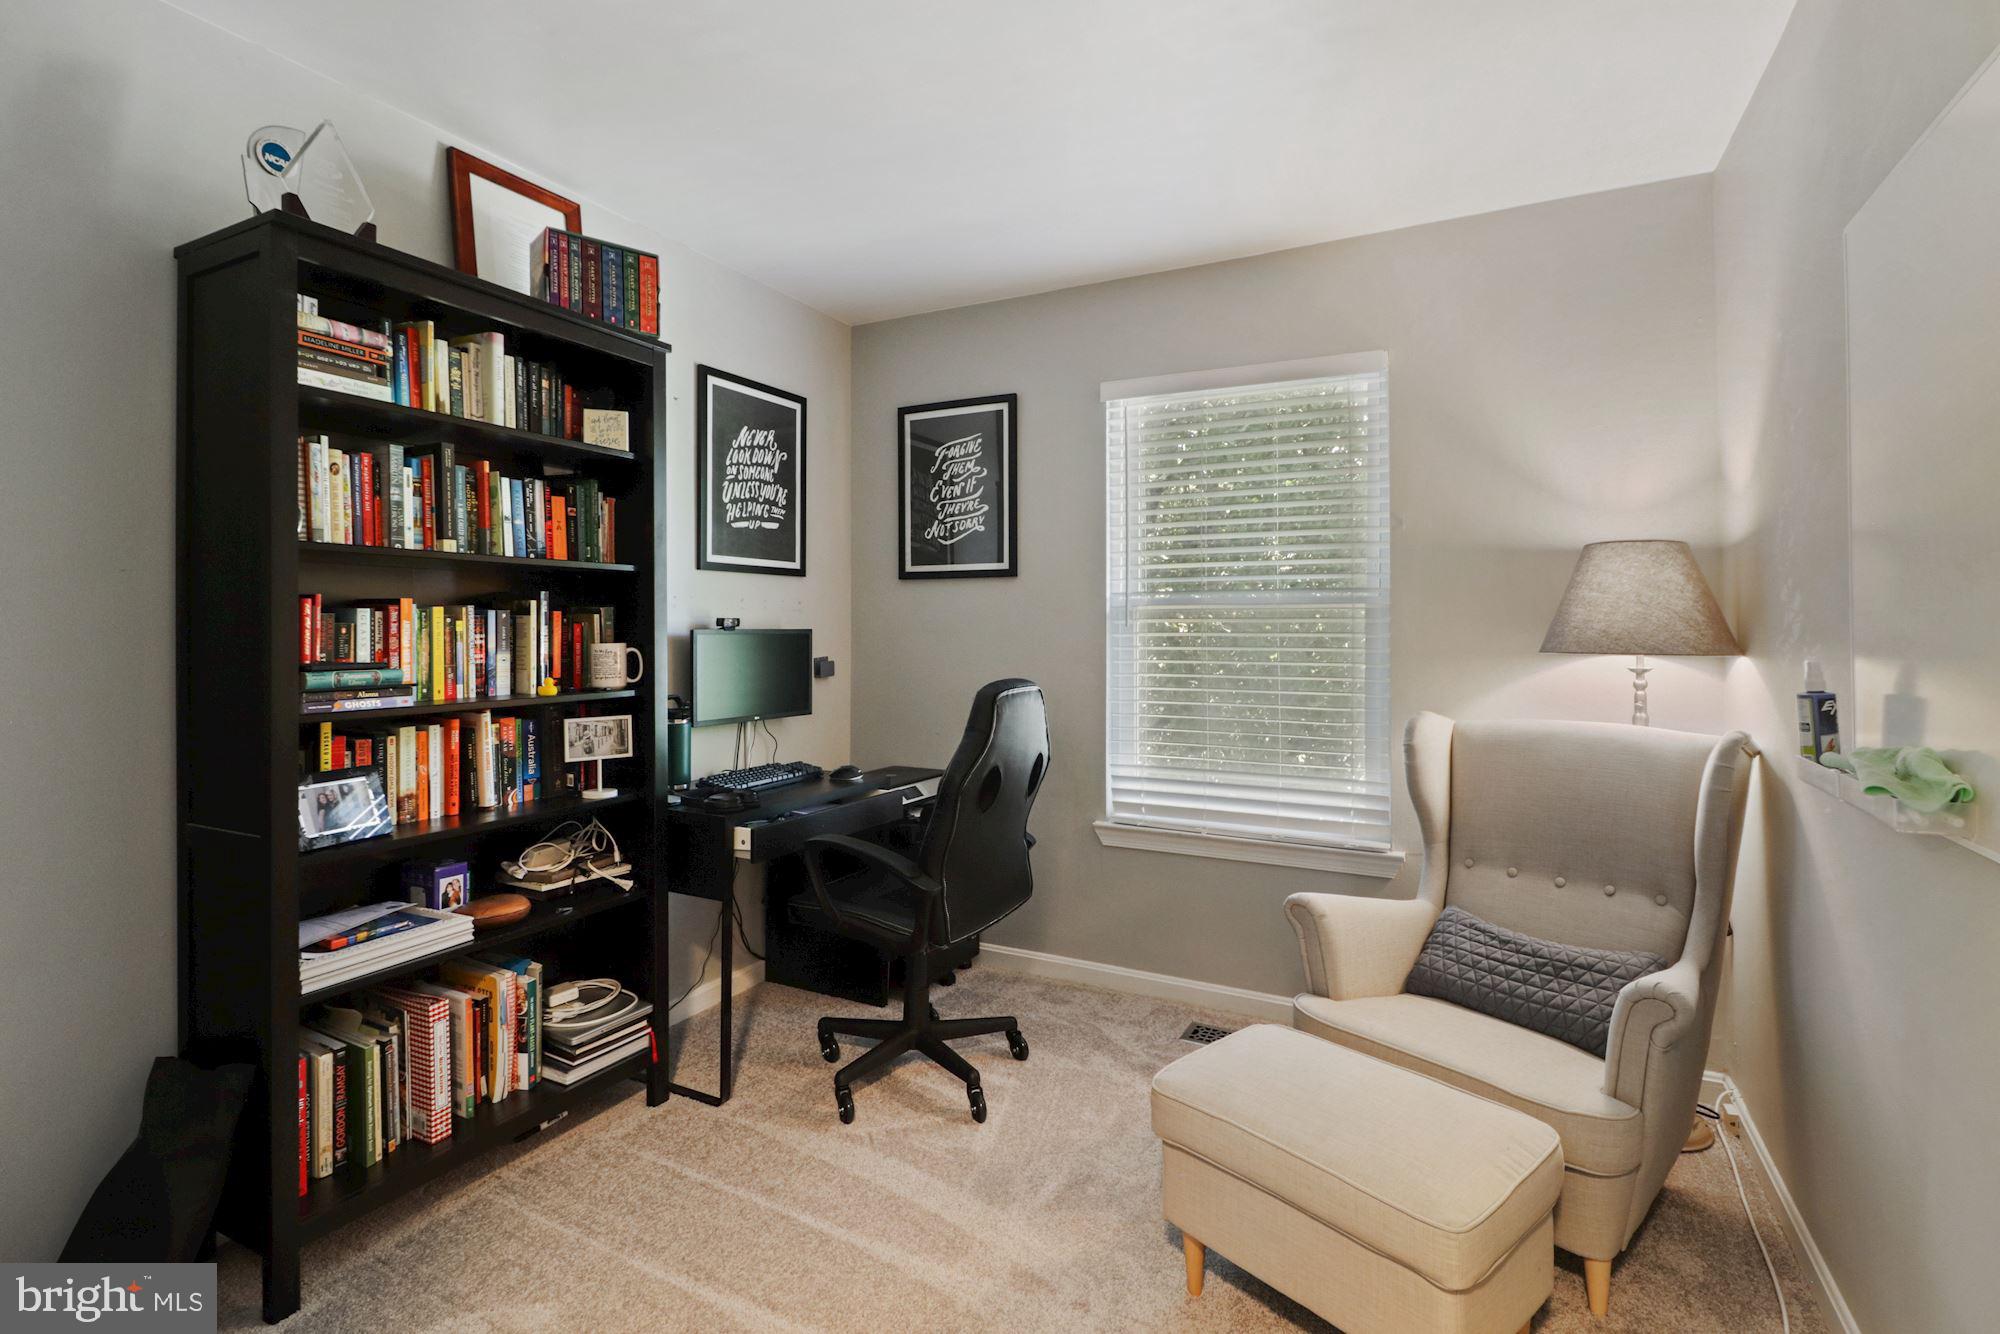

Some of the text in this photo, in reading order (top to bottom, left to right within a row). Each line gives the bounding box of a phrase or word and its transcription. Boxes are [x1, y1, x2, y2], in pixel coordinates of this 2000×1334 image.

[303, 336, 366, 357] MADELINE MILLER
[733, 425, 777, 450] NEVER
[726, 448, 787, 474] LOOK DOWN
[931, 433, 982, 473] FORGIVE
[725, 465, 774, 482] ON SOMEONE
[942, 452, 982, 480] THEM
[722, 481, 788, 507] UNLESS YOU'RE
[930, 480, 965, 502] EVEN
[726, 502, 786, 522] HELPING THEM
[749, 520, 761, 529] UP
[925, 515, 985, 539] NOT SORRY
[344, 700, 382, 709] GHOSTS
[526, 734, 538, 775] Australia
[335, 1065, 348, 1148] GORDON RAMSAY
